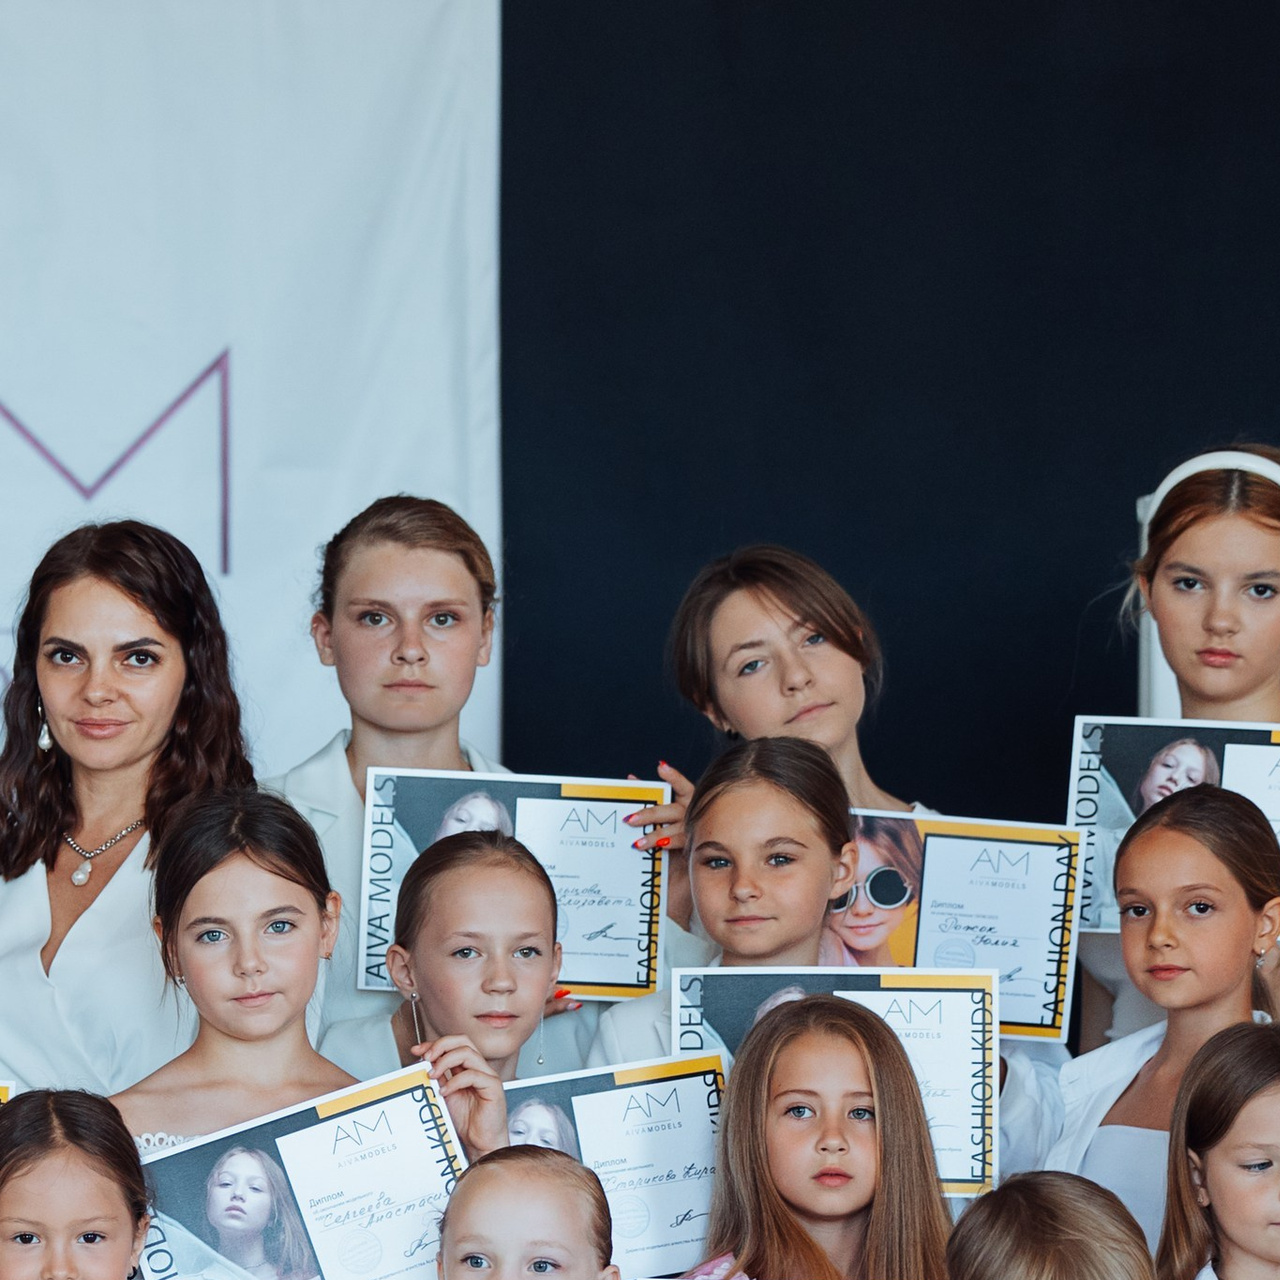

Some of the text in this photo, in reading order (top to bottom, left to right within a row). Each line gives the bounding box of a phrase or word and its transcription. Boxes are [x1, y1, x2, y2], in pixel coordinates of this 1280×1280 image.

[560, 807, 617, 834] AM
[559, 840, 615, 849] AIVAMODELS
[970, 848, 1030, 876] AM
[365, 777, 397, 980] AIVA MODELS
[637, 871, 662, 984] FASHION
[1040, 834, 1080, 1028] FASHION DAY
[680, 977, 704, 1050] DELS
[883, 999, 943, 1025] AM
[971, 990, 994, 1181] FASHION KIDS
[411, 1086, 452, 1149] KIDS
[623, 1088, 681, 1122] AM
[333, 1110, 393, 1155] AM
[625, 1121, 683, 1137] AIVAMODELS
[337, 1143, 398, 1169] AIVAMODELS
[594, 1158, 627, 1170] Диплом
[309, 1190, 345, 1208] Диплом
